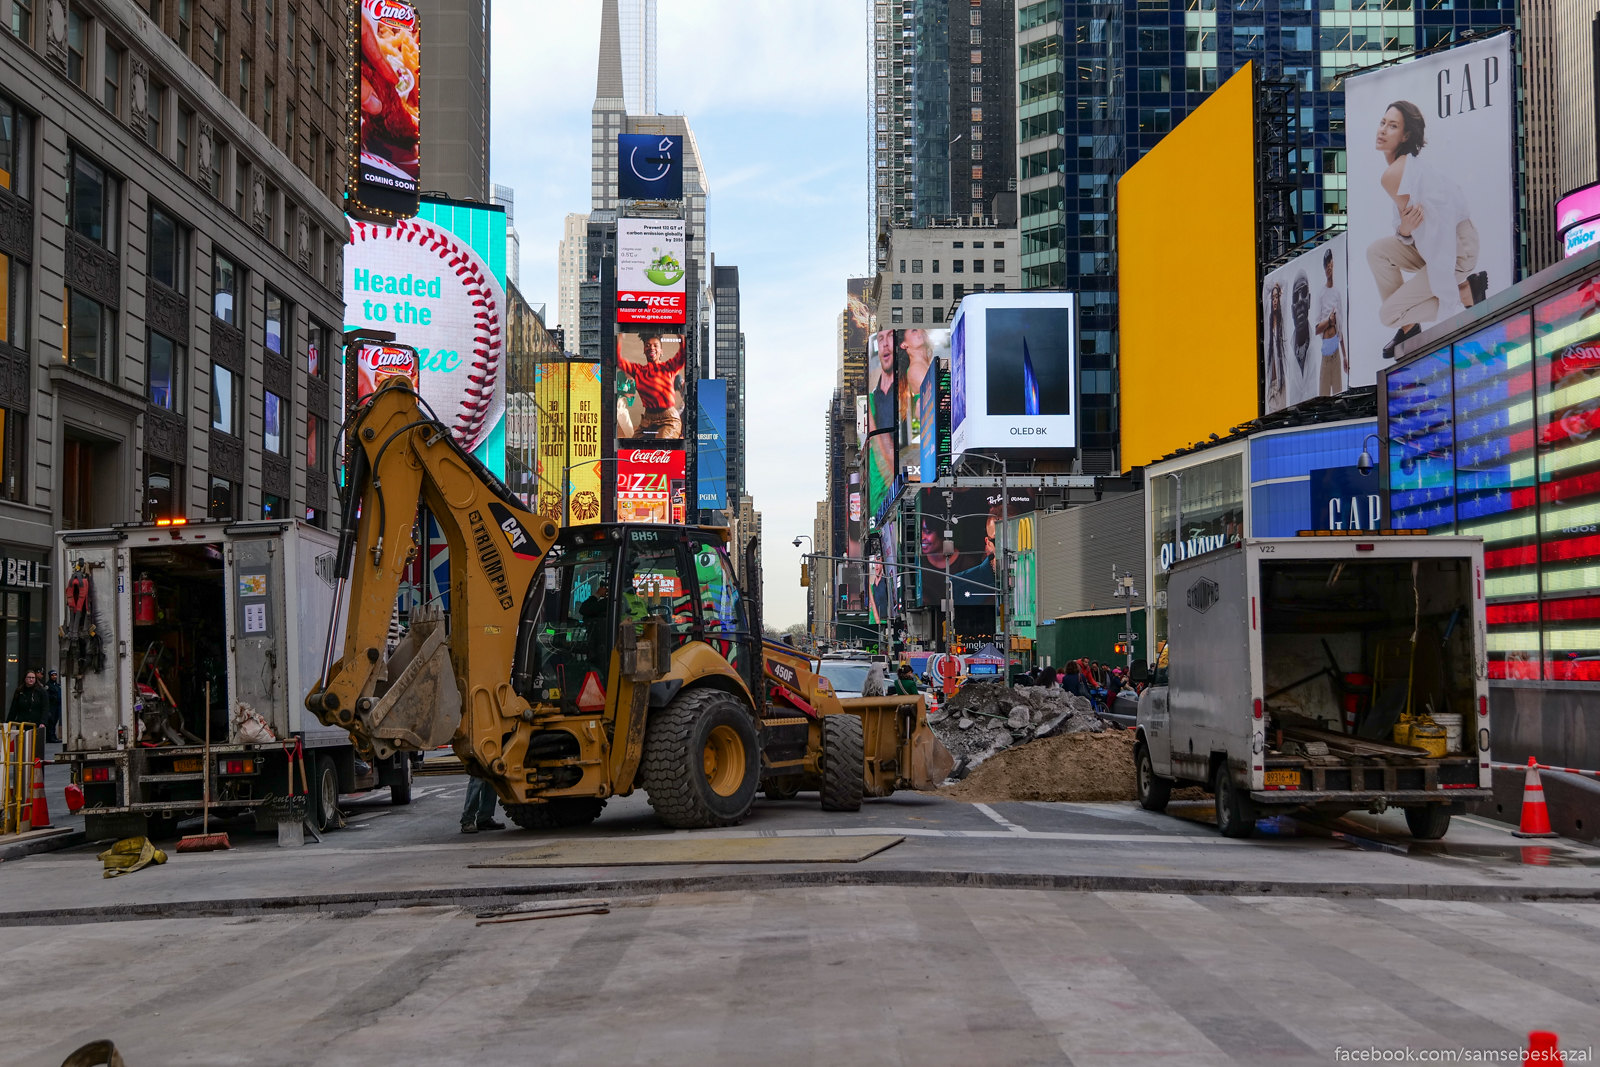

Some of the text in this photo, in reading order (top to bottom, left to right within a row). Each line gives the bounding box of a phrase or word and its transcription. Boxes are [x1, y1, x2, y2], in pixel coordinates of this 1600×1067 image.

[1437, 56, 1499, 119] GAP
[364, 173, 416, 191] COMING SOON
[354, 267, 441, 299] Headed
[363, 299, 432, 326] to the
[651, 307, 683, 315] Conditioning
[367, 347, 412, 370] Cane's
[579, 400, 591, 412] GET
[573, 412, 598, 424] TICKETS
[573, 424, 597, 443] HERE
[1010, 427, 1048, 436] OLED 8K
[573, 443, 597, 457] TODAY
[630, 449, 673, 463] Coca-Cola
[617, 473, 668, 491] PIZZA
[699, 493, 717, 501] PGIM
[1328, 494, 1381, 530] GAP
[501, 517, 527, 549] CAT
[631, 531, 658, 541] BH51
[1187, 533, 1225, 560] NAVY
[1260, 545, 1275, 553] V22
[7, 557, 44, 588] BELL
[774, 664, 793, 682] 450F
